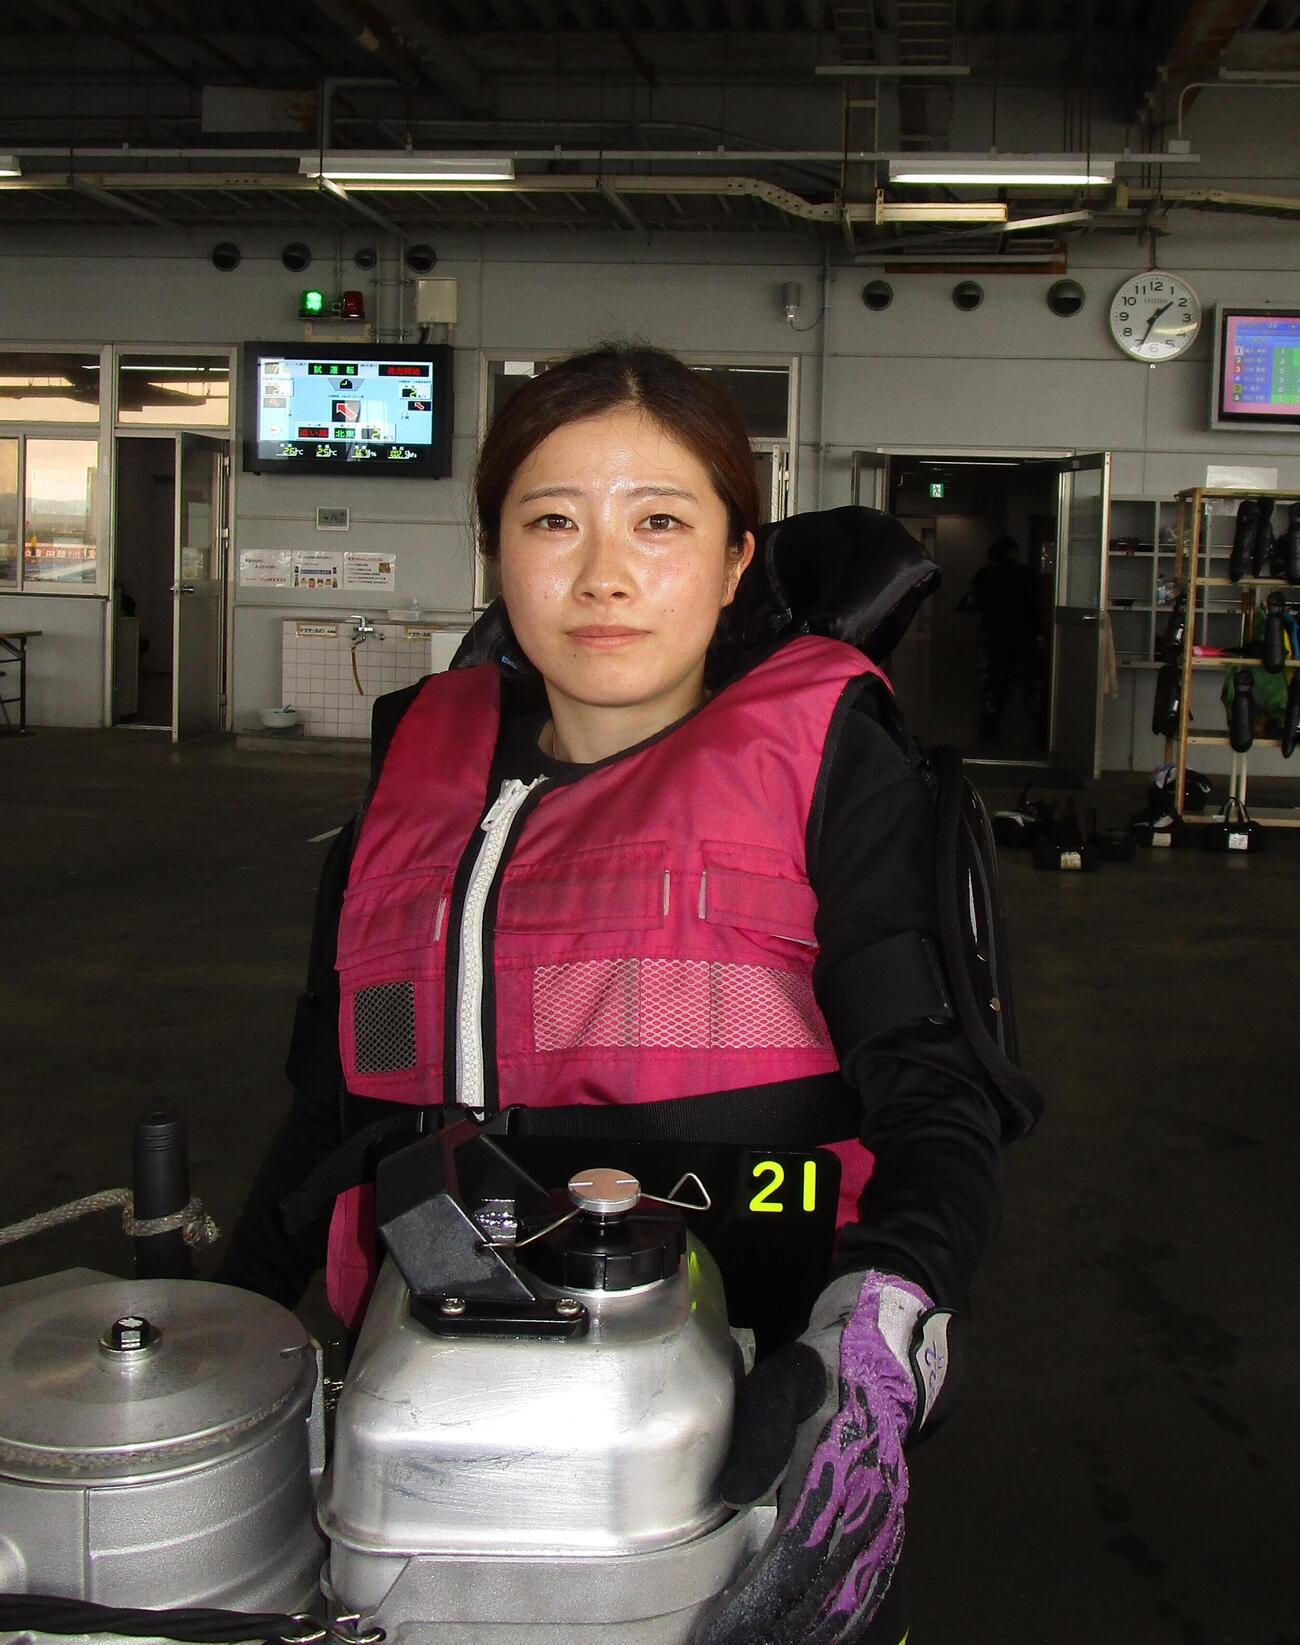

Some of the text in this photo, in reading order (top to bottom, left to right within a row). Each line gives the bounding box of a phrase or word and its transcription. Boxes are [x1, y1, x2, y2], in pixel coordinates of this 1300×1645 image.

[1135, 285, 1146, 295] 11
[1150, 281, 1164, 292] 12
[1170, 286, 1175, 296] 1
[1121, 296, 1137, 306] 10
[1178, 297, 1188, 307] 2
[1119, 311, 1129, 321] 9
[1182, 313, 1192, 323] 3
[1123, 327, 1132, 337] 8
[1149, 343, 1160, 353] 6
[1165, 339, 1175, 348] 5
[750, 1161, 816, 1212] 21
